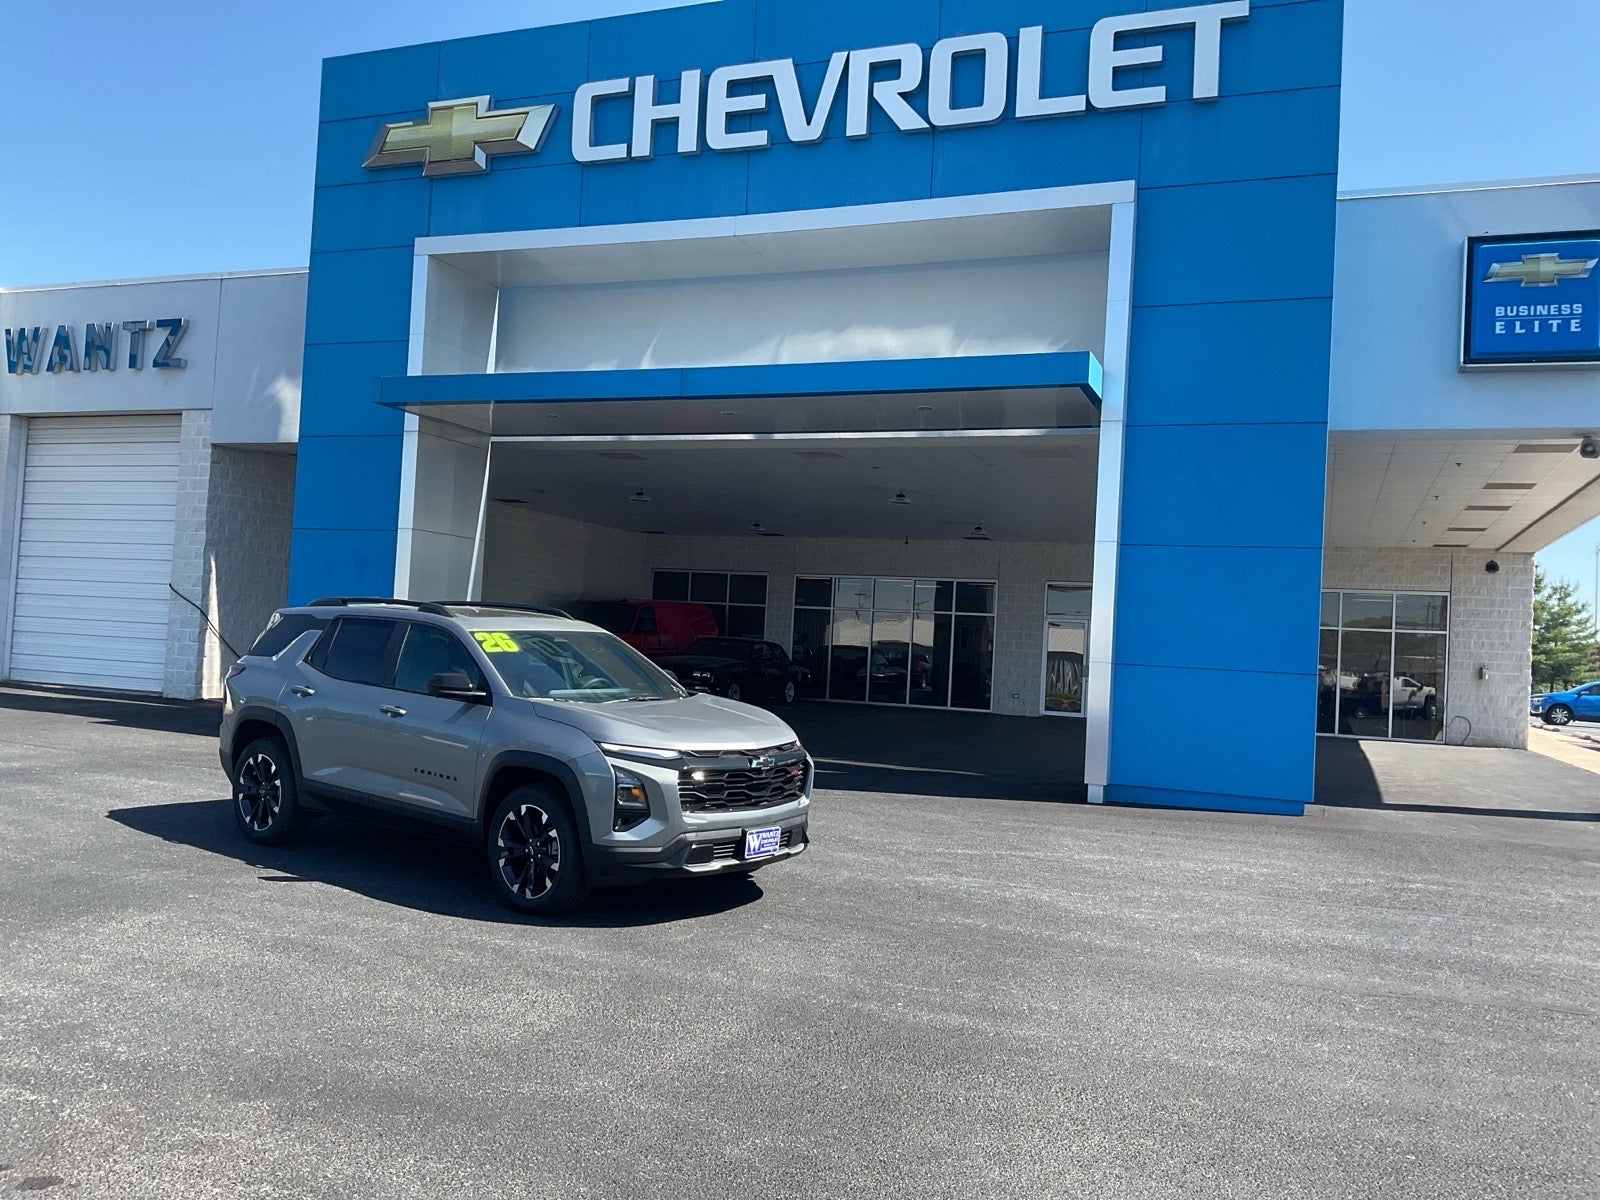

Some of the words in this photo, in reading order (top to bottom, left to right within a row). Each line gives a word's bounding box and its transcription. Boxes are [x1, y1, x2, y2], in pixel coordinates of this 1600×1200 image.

[571, 1, 1250, 164] CHEVROLET
[1495, 304, 1582, 317] BUSINESS
[1495, 319, 1582, 334] ELITE
[5, 317, 189, 375] WANTZ
[474, 632, 519, 653] 26
